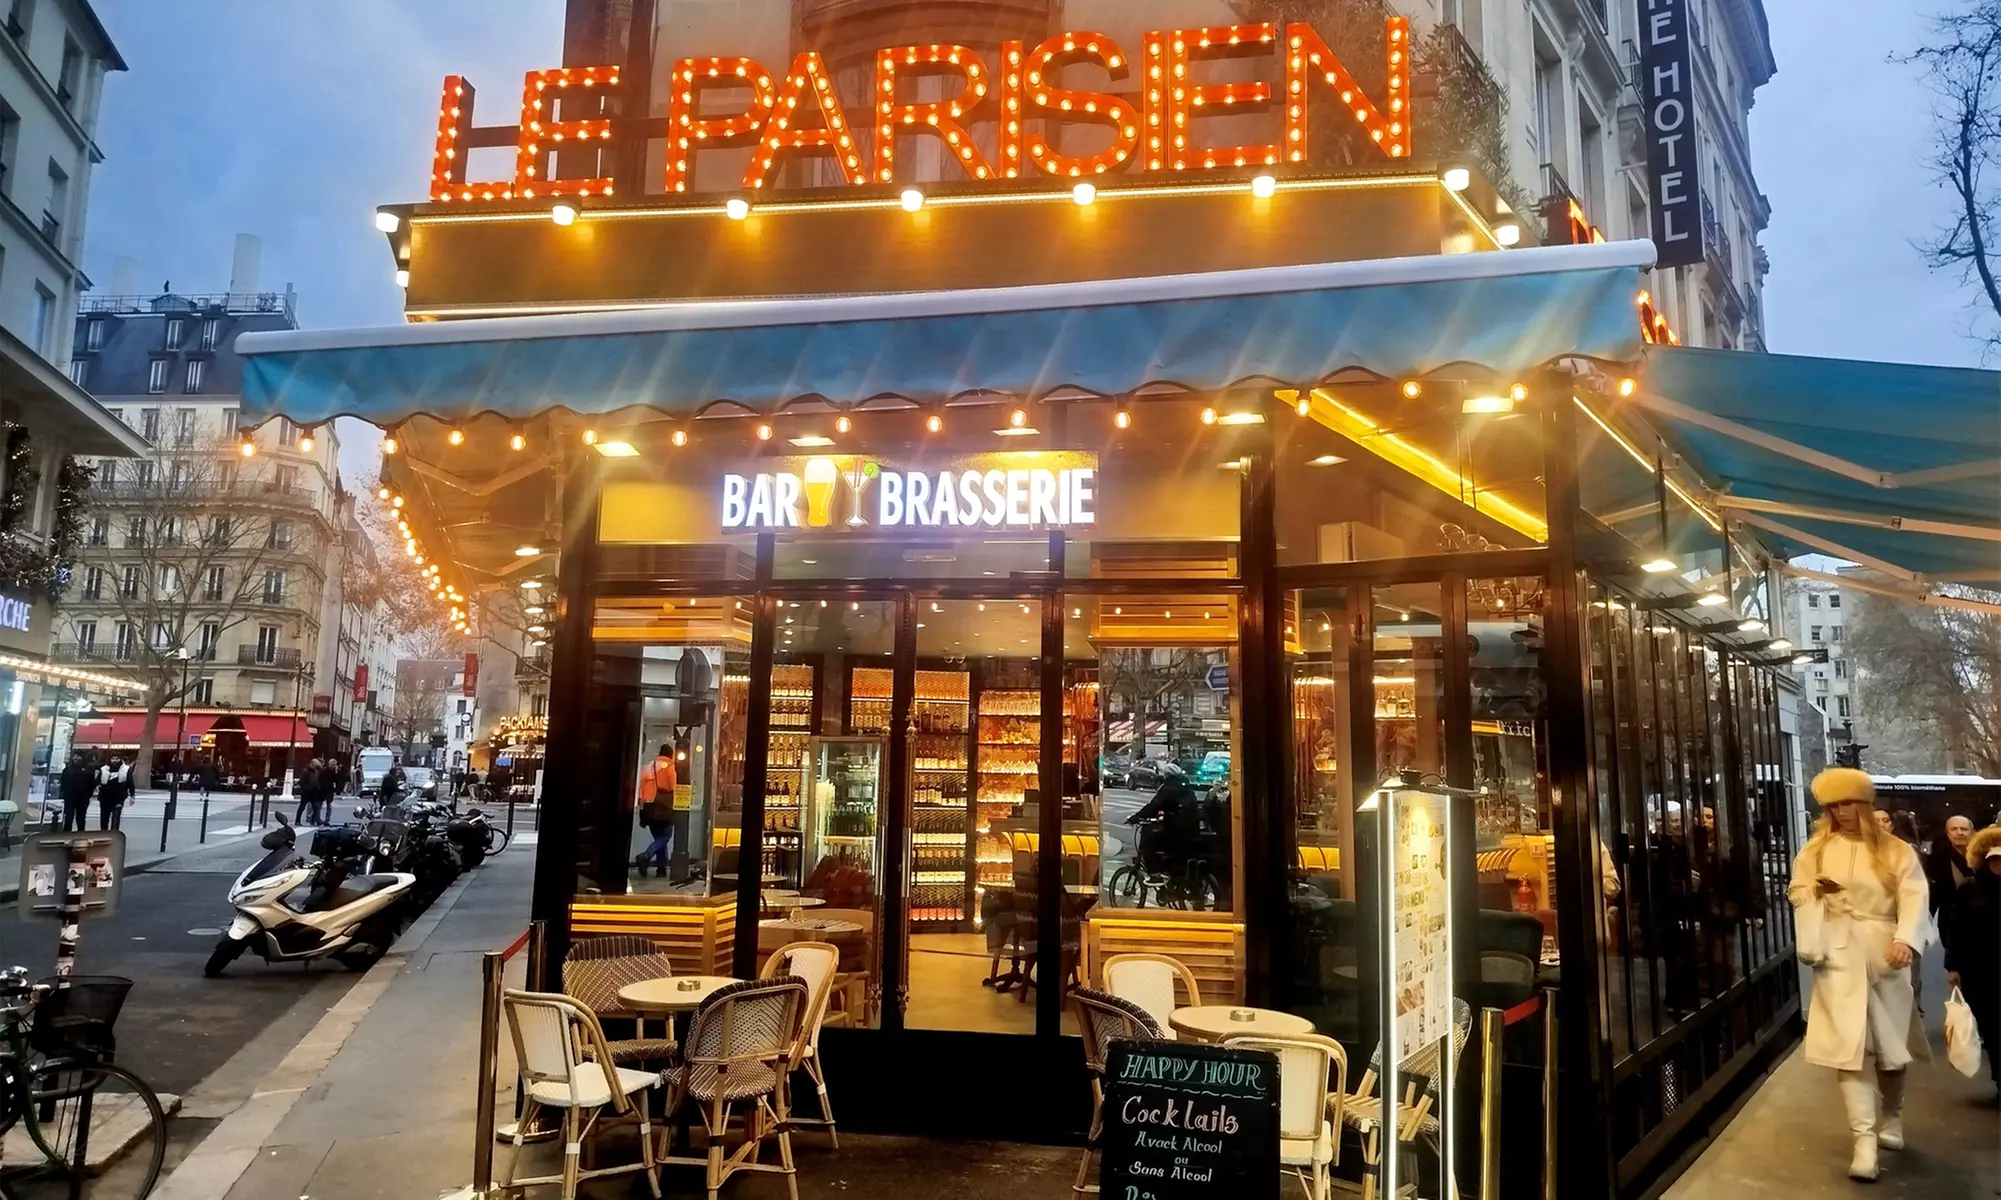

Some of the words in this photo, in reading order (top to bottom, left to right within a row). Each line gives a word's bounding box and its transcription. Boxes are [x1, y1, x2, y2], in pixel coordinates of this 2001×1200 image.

[1648, 0, 1677, 46] E
[431, 66, 620, 202] LE
[665, 16, 1411, 193] PARISIEN
[1653, 61, 1689, 242] HOTEL
[721, 473, 800, 527] BAR
[879, 468, 1096, 526] BRASSERIE
[1120, 1054, 1198, 1081] HAPPY
[1200, 1060, 1266, 1090] HOUR
[1174, 1156, 1189, 1165] ou
[1183, 1137, 1223, 1154] Alcool
[1128, 1160, 1165, 1178] Sans
[1170, 1167, 1213, 1183] Alcool
